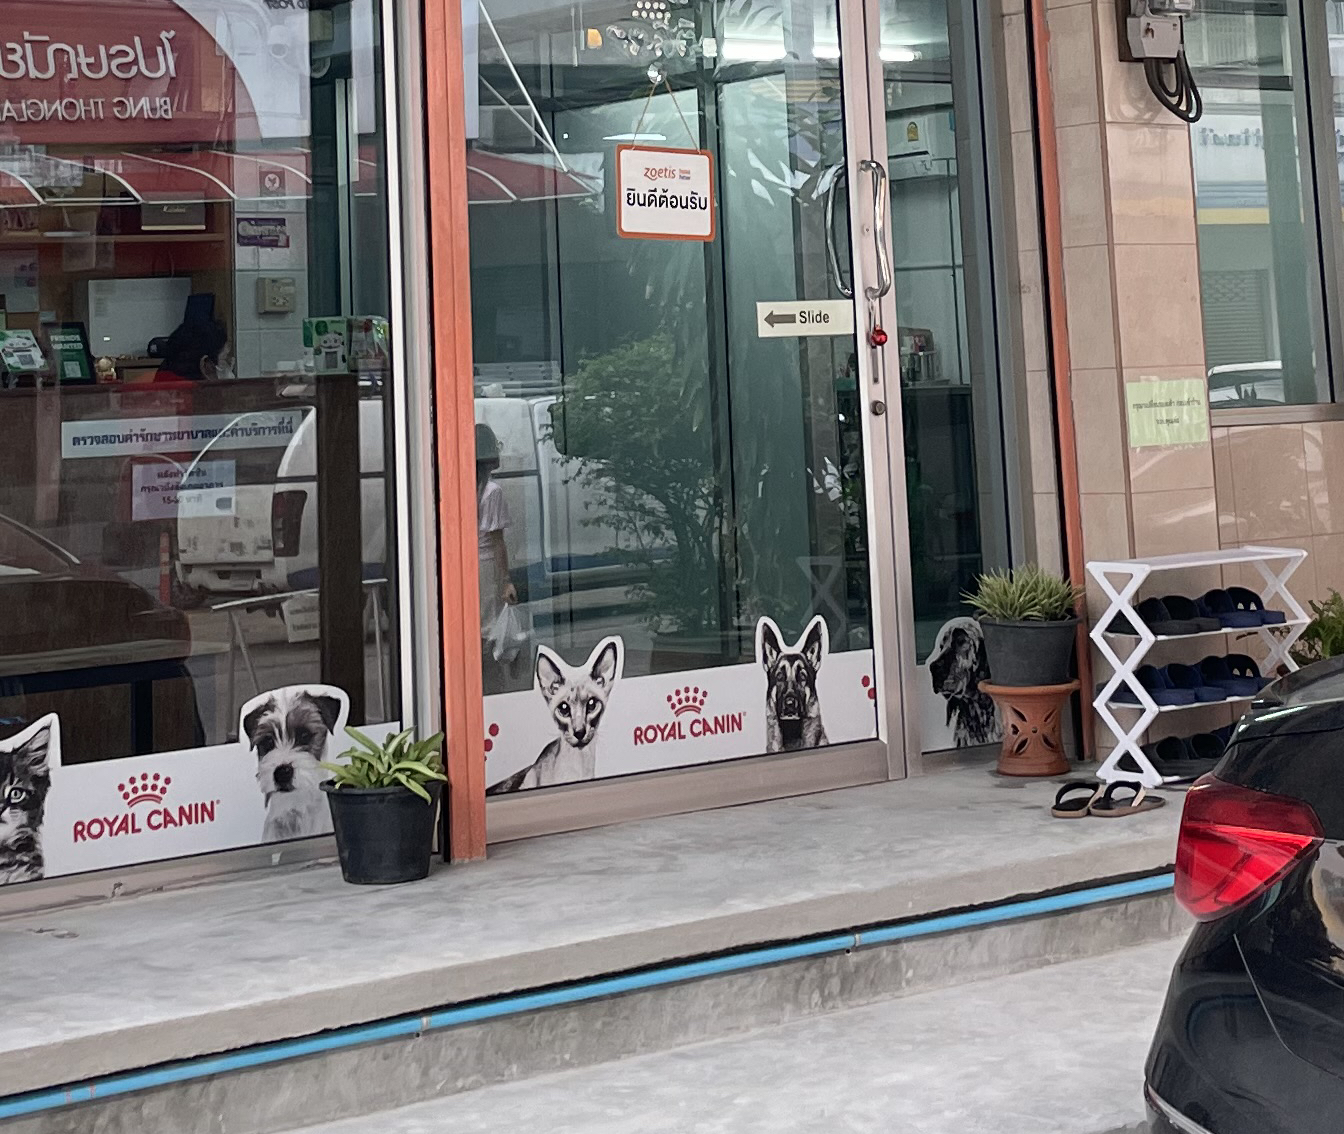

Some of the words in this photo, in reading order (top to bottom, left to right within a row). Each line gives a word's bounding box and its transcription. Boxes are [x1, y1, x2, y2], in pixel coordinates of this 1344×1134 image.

[644, 166, 676, 181] zoetis
[626, 187, 708, 211] ยินดีต้อนรับ
[799, 310, 830, 324] Slide
[634, 721, 686, 746] ROYAL
[690, 712, 743, 738] CANIN
[73, 812, 142, 843] ROYAL
[146, 800, 215, 831] CANIN
